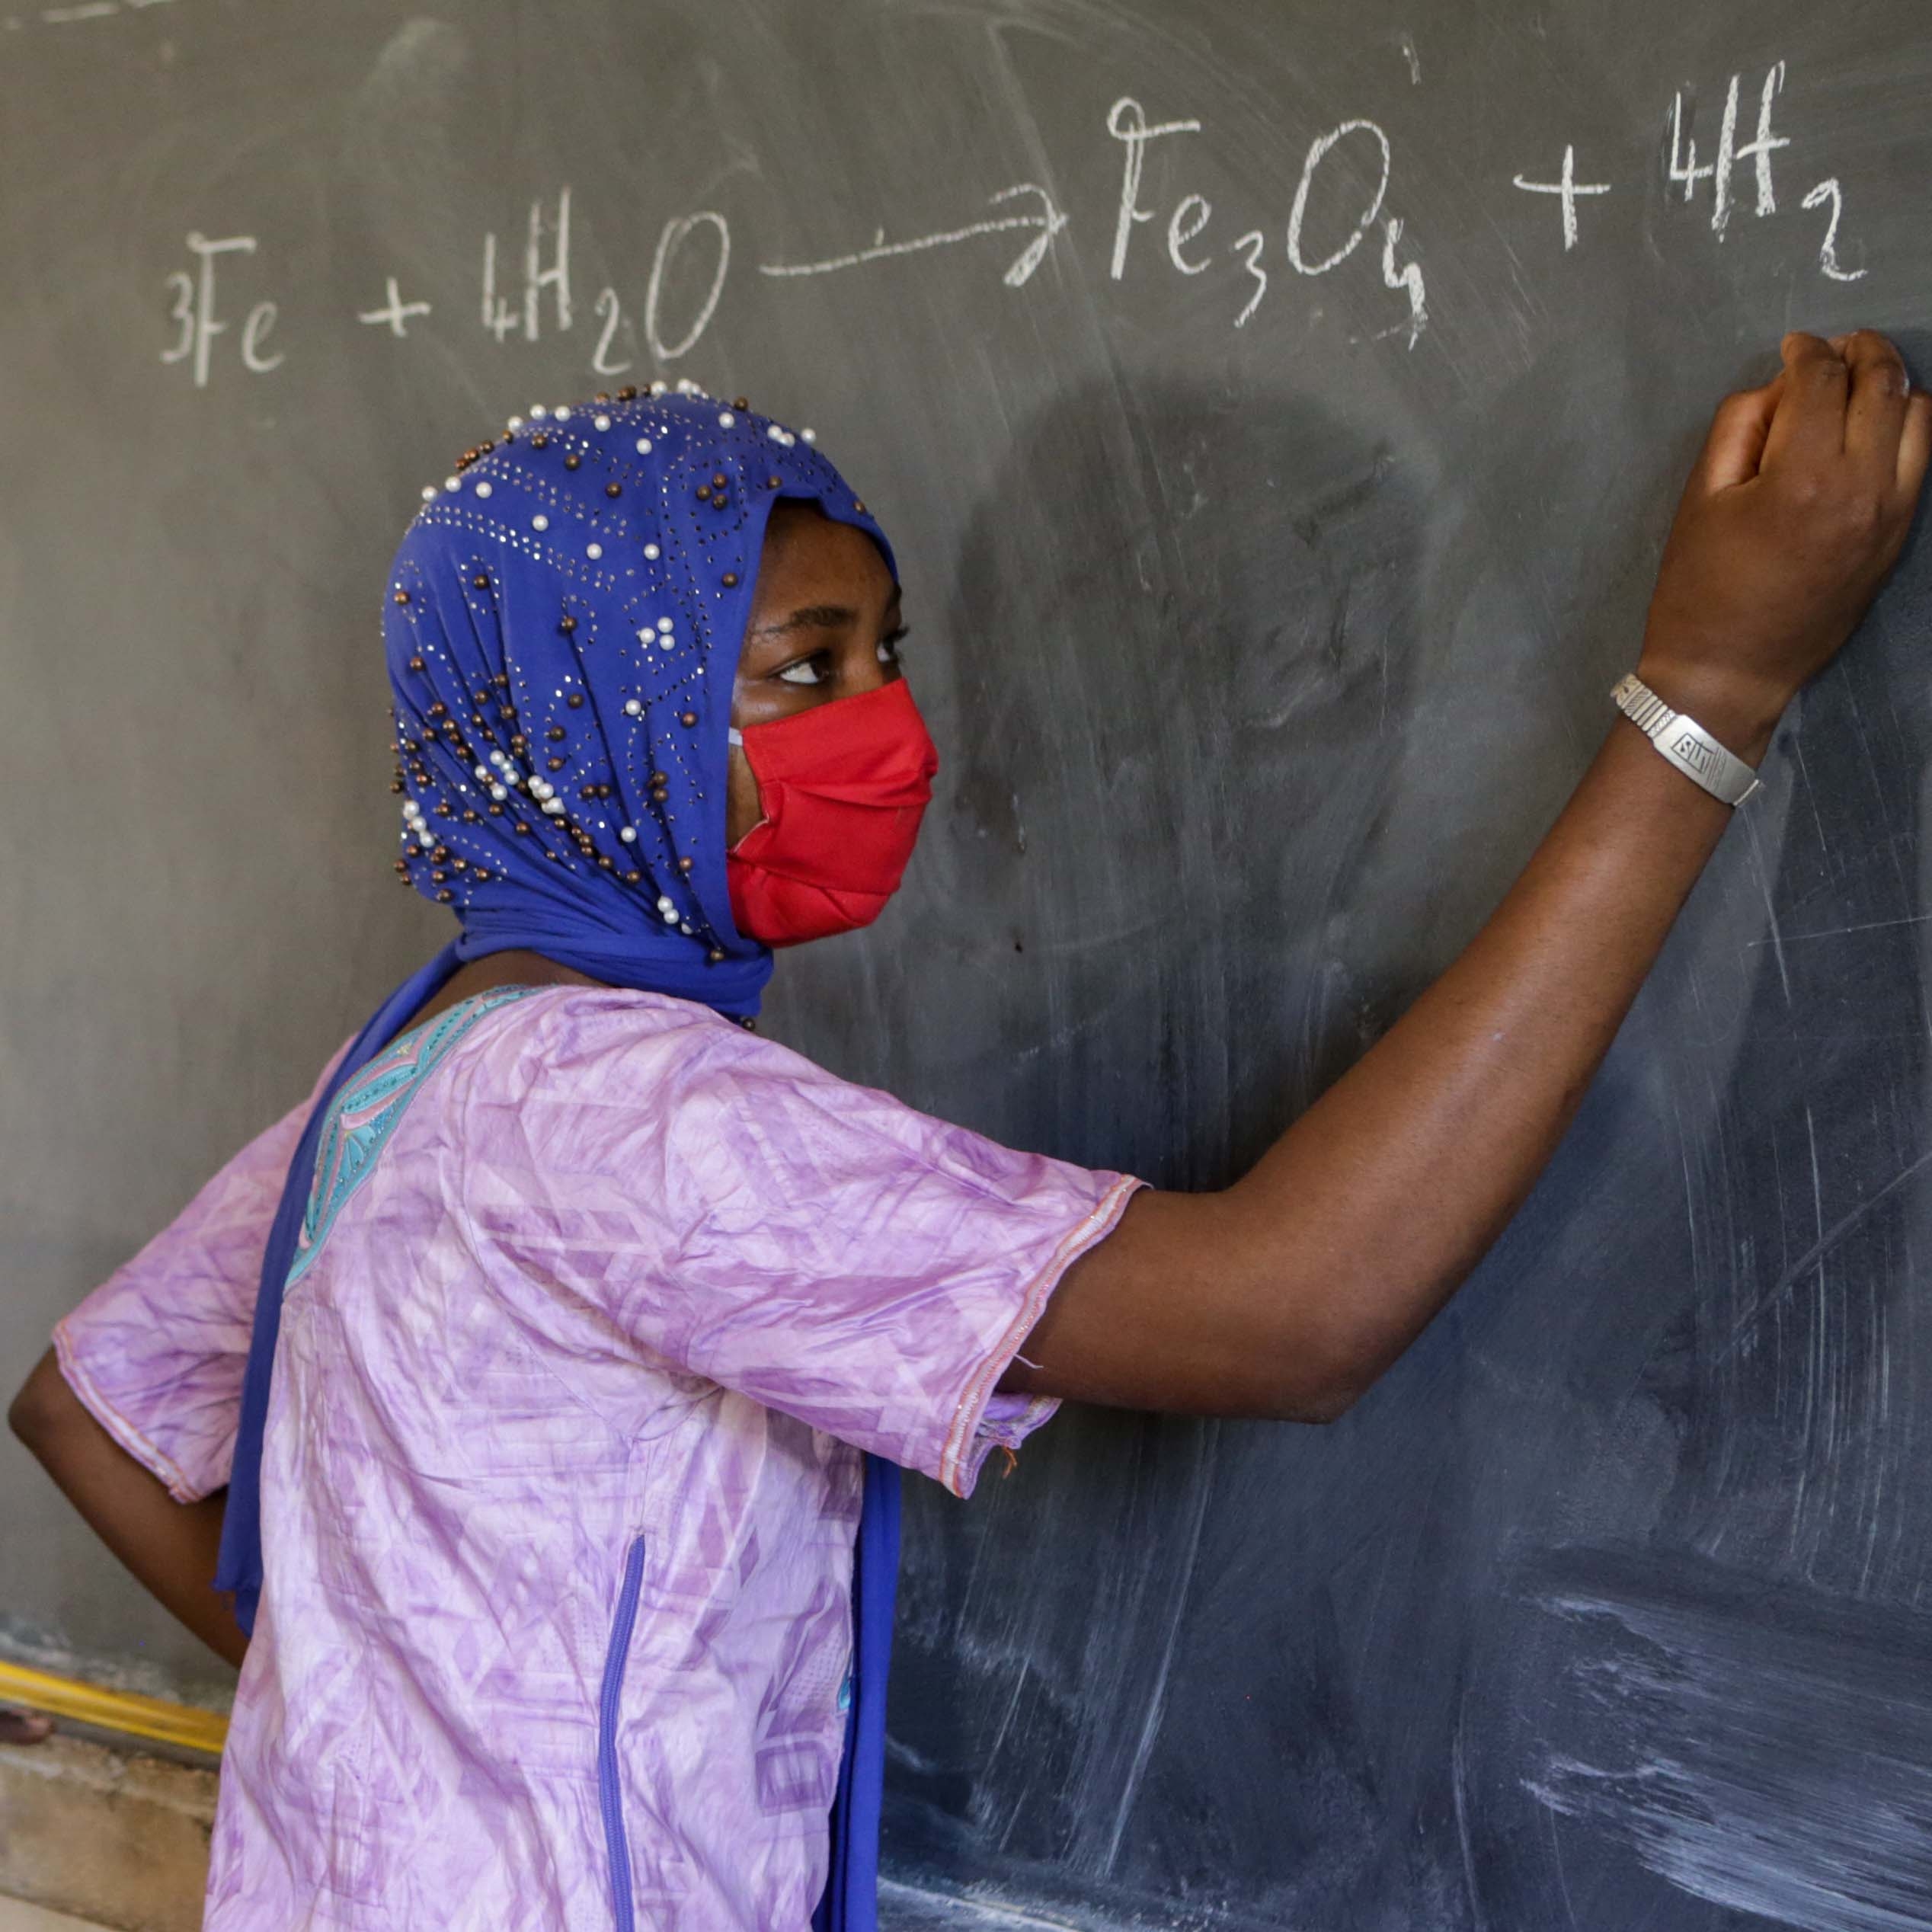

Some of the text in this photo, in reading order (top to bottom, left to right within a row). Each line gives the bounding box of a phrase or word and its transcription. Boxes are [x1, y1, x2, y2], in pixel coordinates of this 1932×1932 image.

[161, 232, 286, 388] 3Fe
[358, 277, 432, 338] +
[1513, 145, 1611, 251] +
